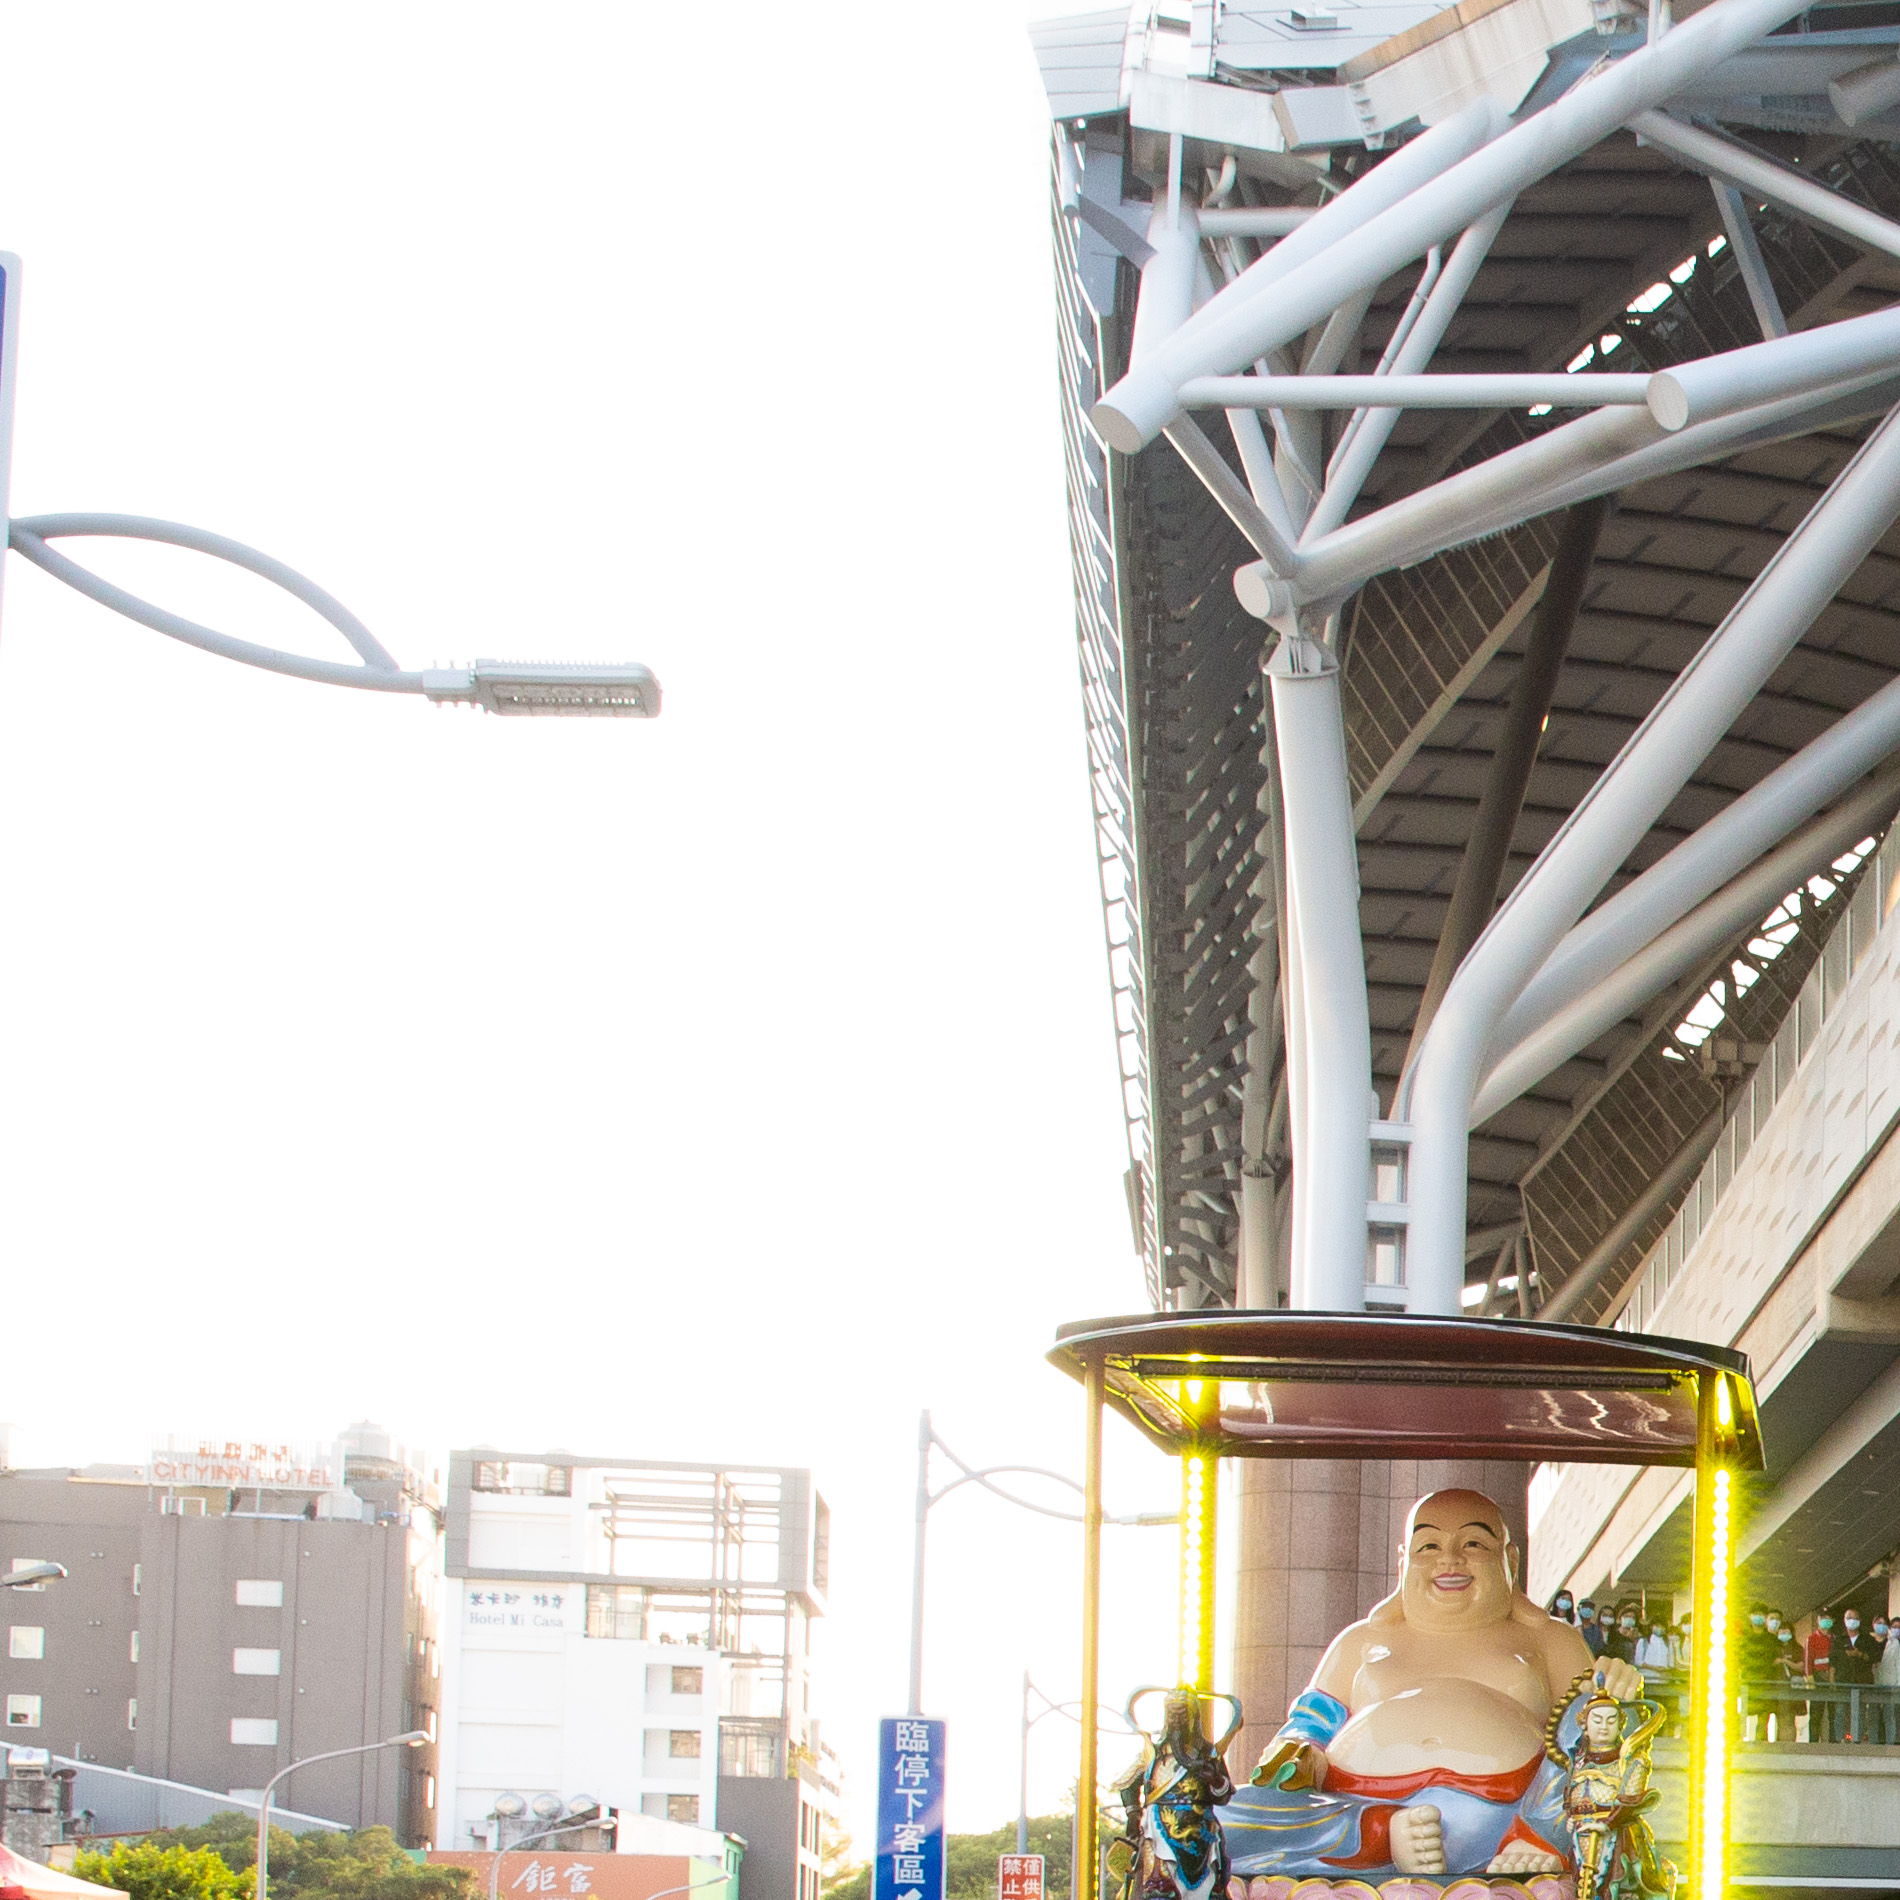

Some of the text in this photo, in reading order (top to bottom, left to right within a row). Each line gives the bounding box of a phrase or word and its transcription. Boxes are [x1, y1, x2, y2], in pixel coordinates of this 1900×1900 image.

[470, 1612, 505, 1625] Hotel
[533, 1614, 564, 1628] Casa
[893, 1721, 930, 1886] 臨停下客區
[511, 1860, 595, 1894] 鉅富
